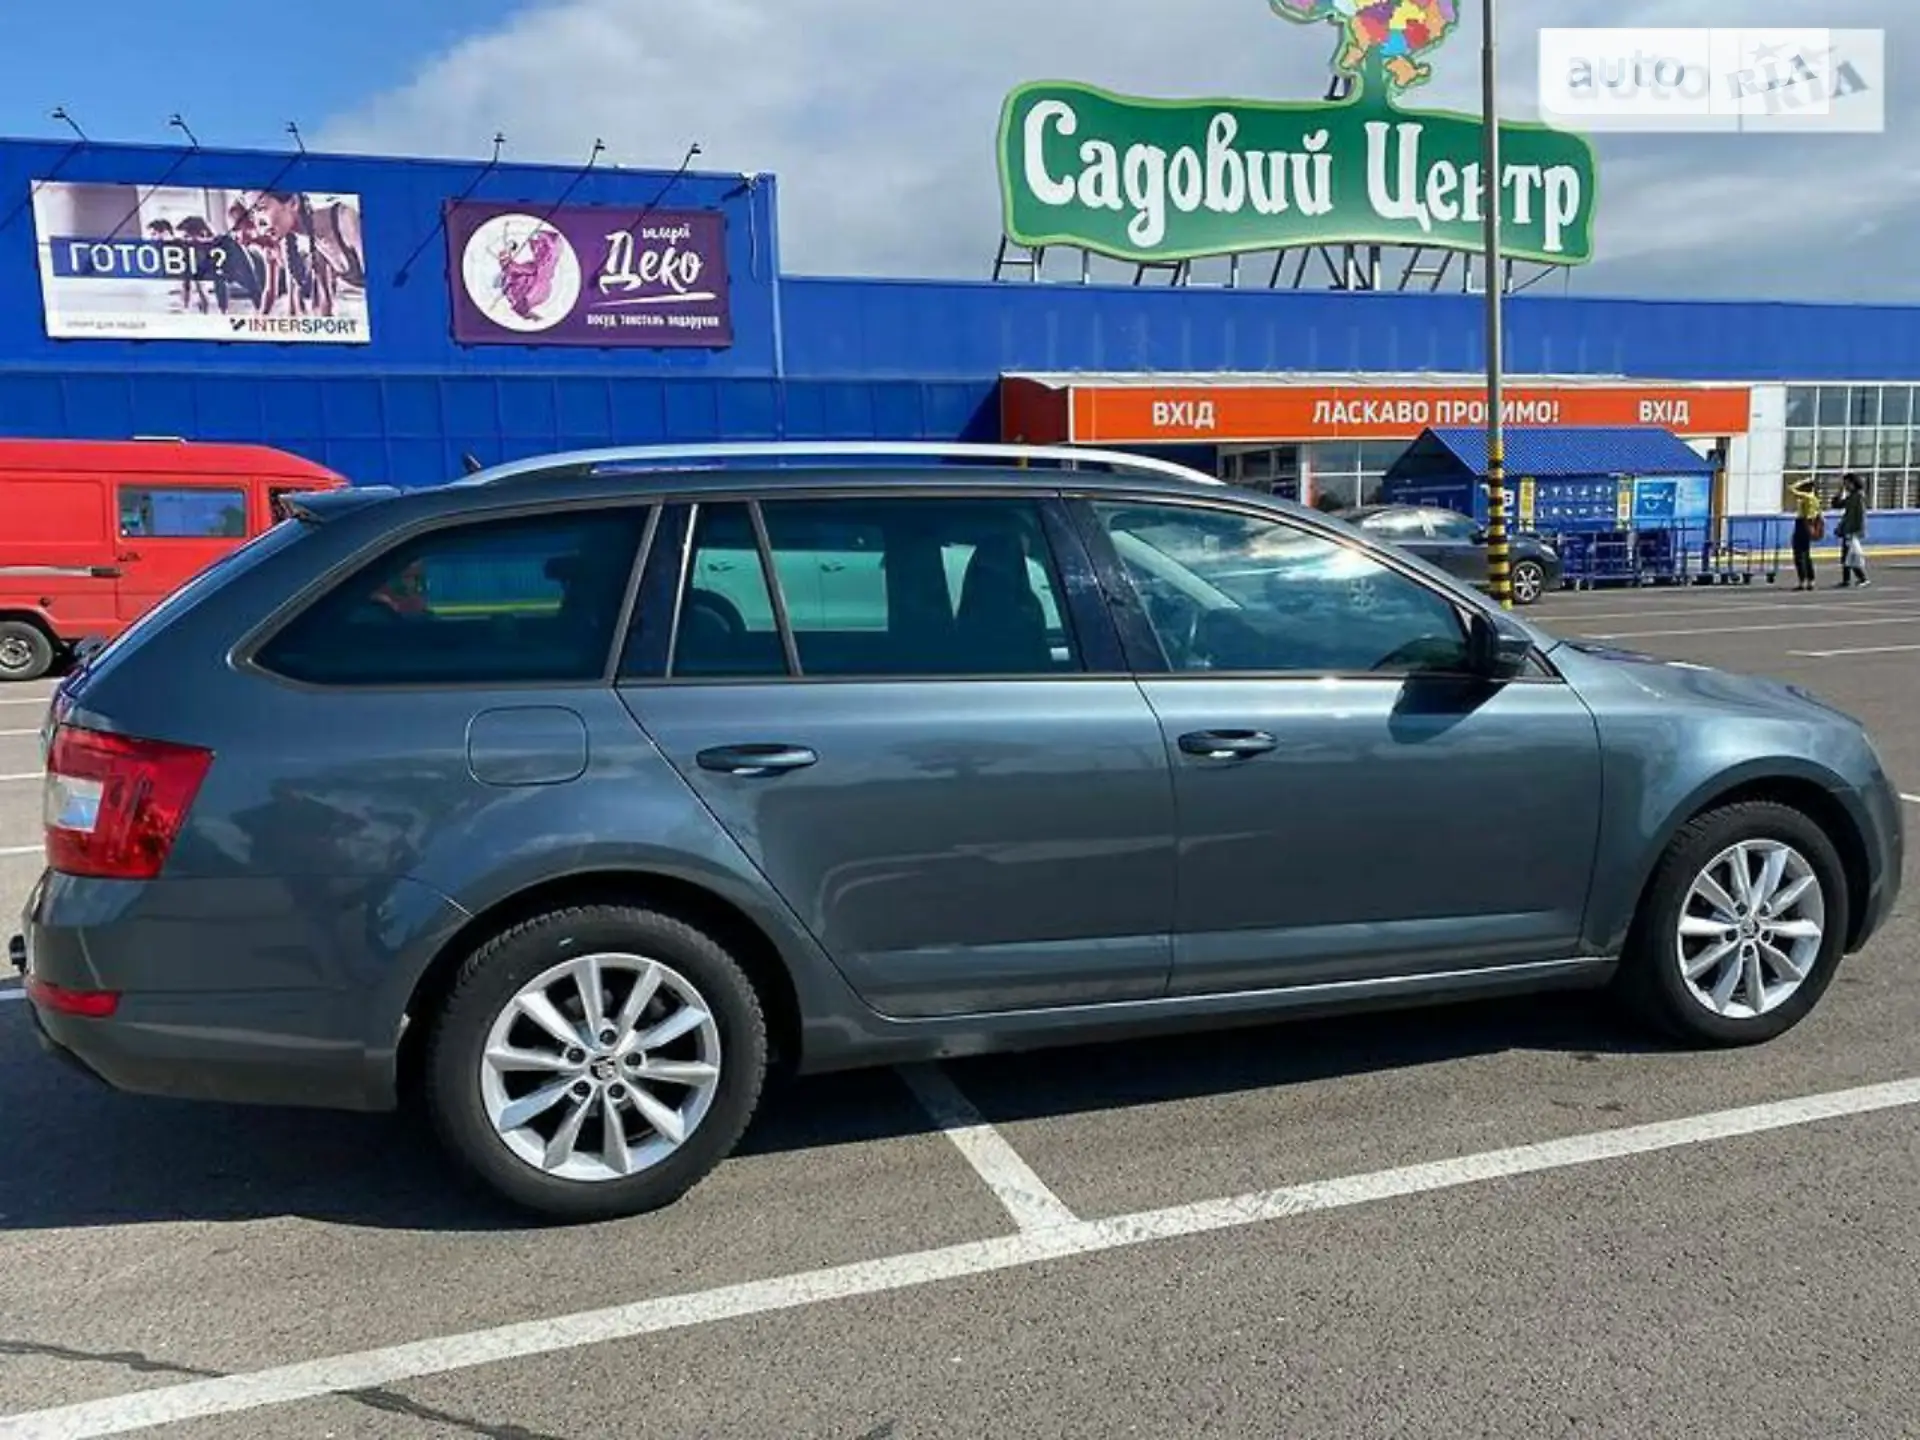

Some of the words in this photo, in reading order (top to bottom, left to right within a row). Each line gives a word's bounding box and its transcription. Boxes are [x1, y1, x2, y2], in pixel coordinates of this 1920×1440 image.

[1023, 100, 1333, 248] Садовий
[69, 243, 198, 274] ГОТОВІ
[211, 249, 227, 275] ?
[599, 230, 703, 294] Деко
[248, 318, 358, 335] INTERSPORT
[1152, 401, 1215, 427] ВХІД
[1312, 400, 1430, 424] ЛАСКАВО
[1435, 400, 1560, 424] ПРОИМО!
[1638, 400, 1690, 425] ВХІД
